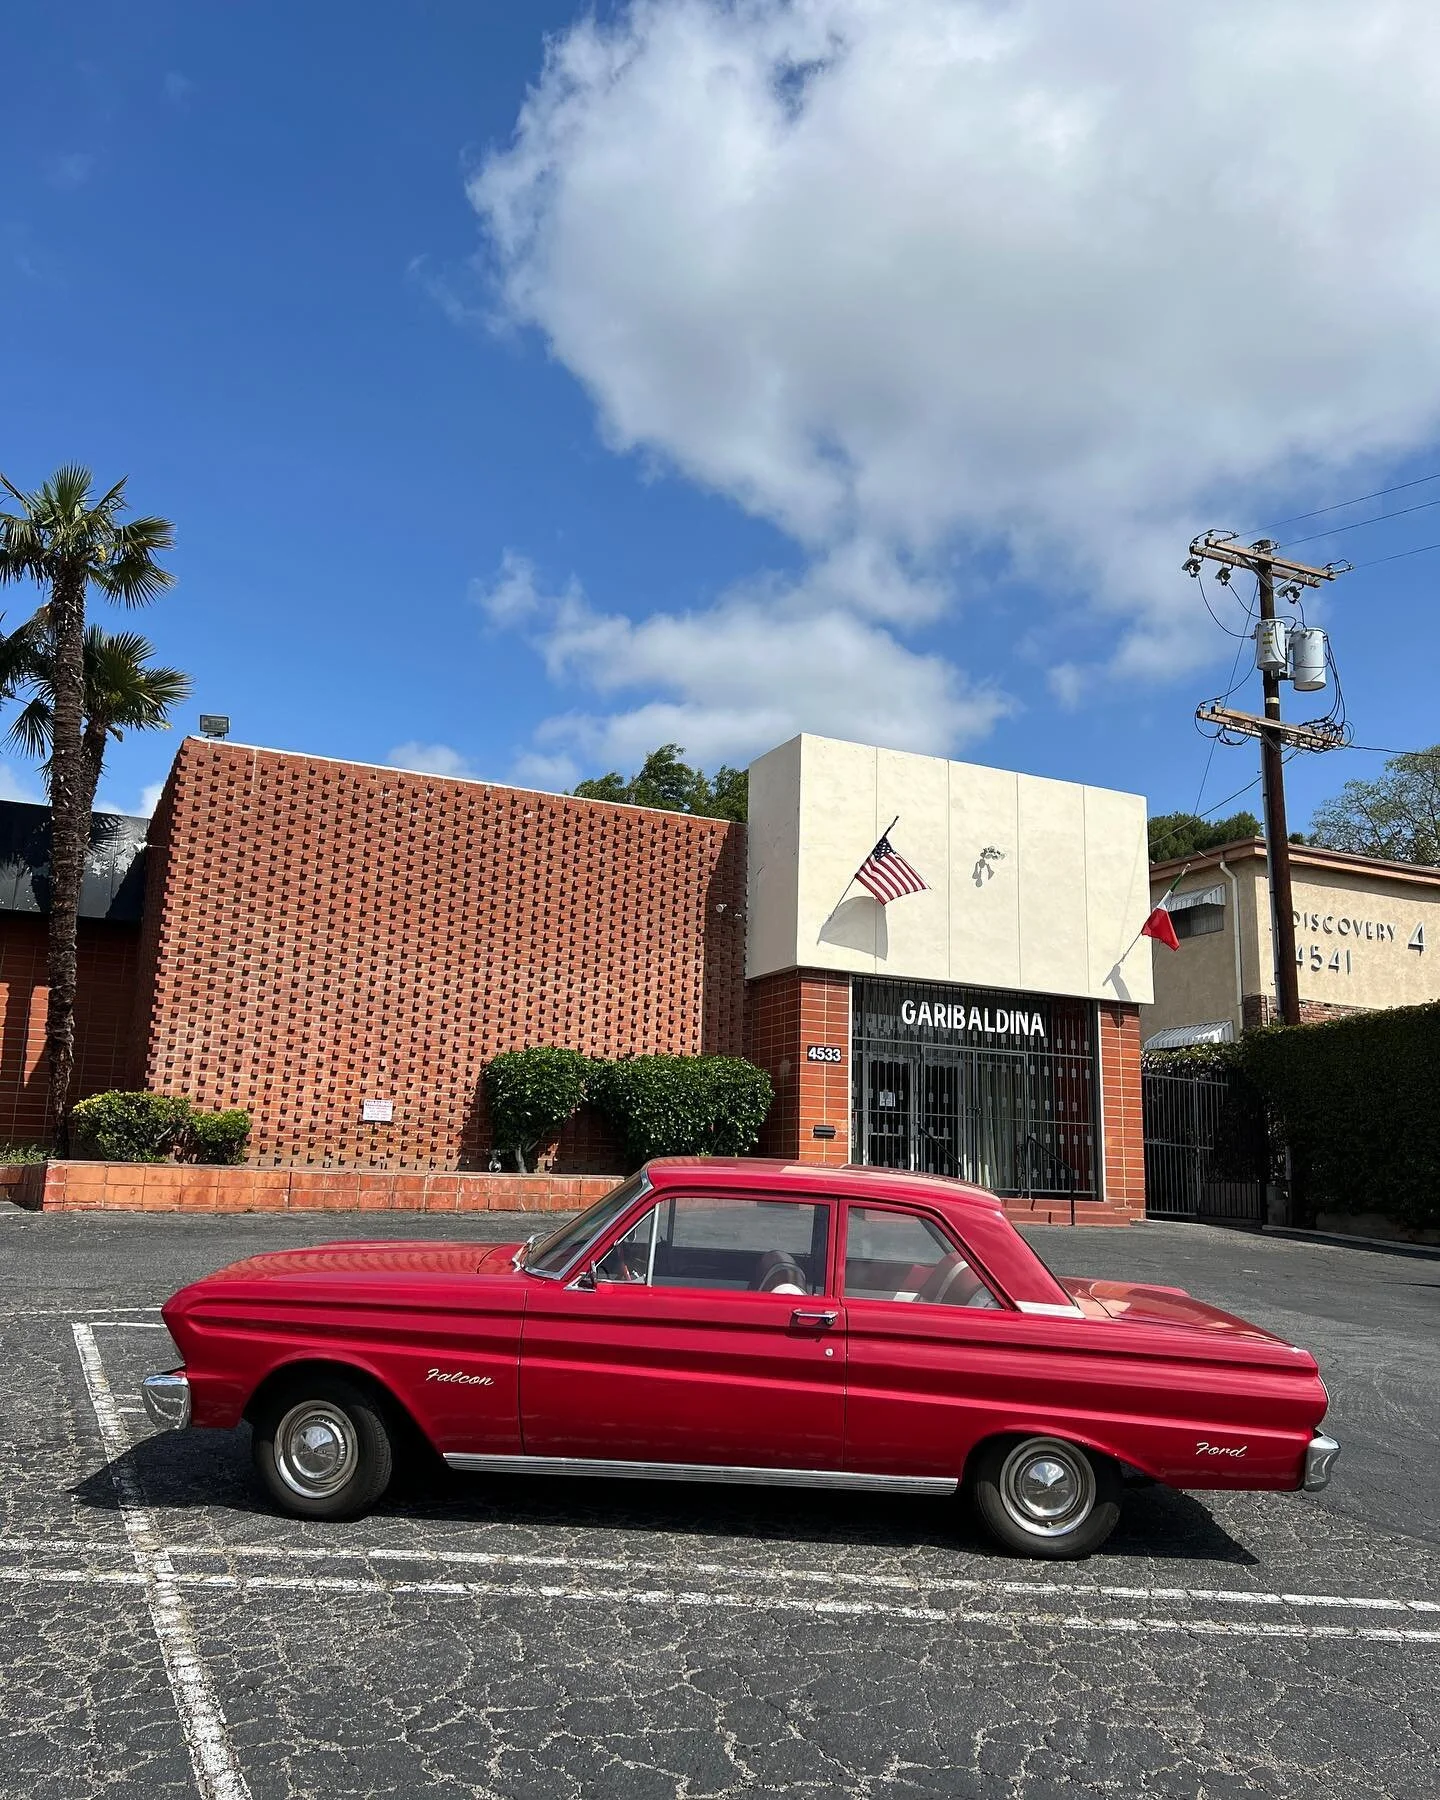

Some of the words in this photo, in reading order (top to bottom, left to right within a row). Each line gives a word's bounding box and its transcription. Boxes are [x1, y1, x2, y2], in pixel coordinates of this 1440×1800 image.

[1292, 910, 1397, 942] DISCOVERY
[1407, 921, 1427, 956] 4
[1295, 943, 1353, 975] 4541
[901, 999, 1045, 1037] GARIBALDINA
[808, 1046, 841, 1061] 4533
[425, 1368, 494, 1386] Falcon
[1195, 1442, 1248, 1457] Ford
